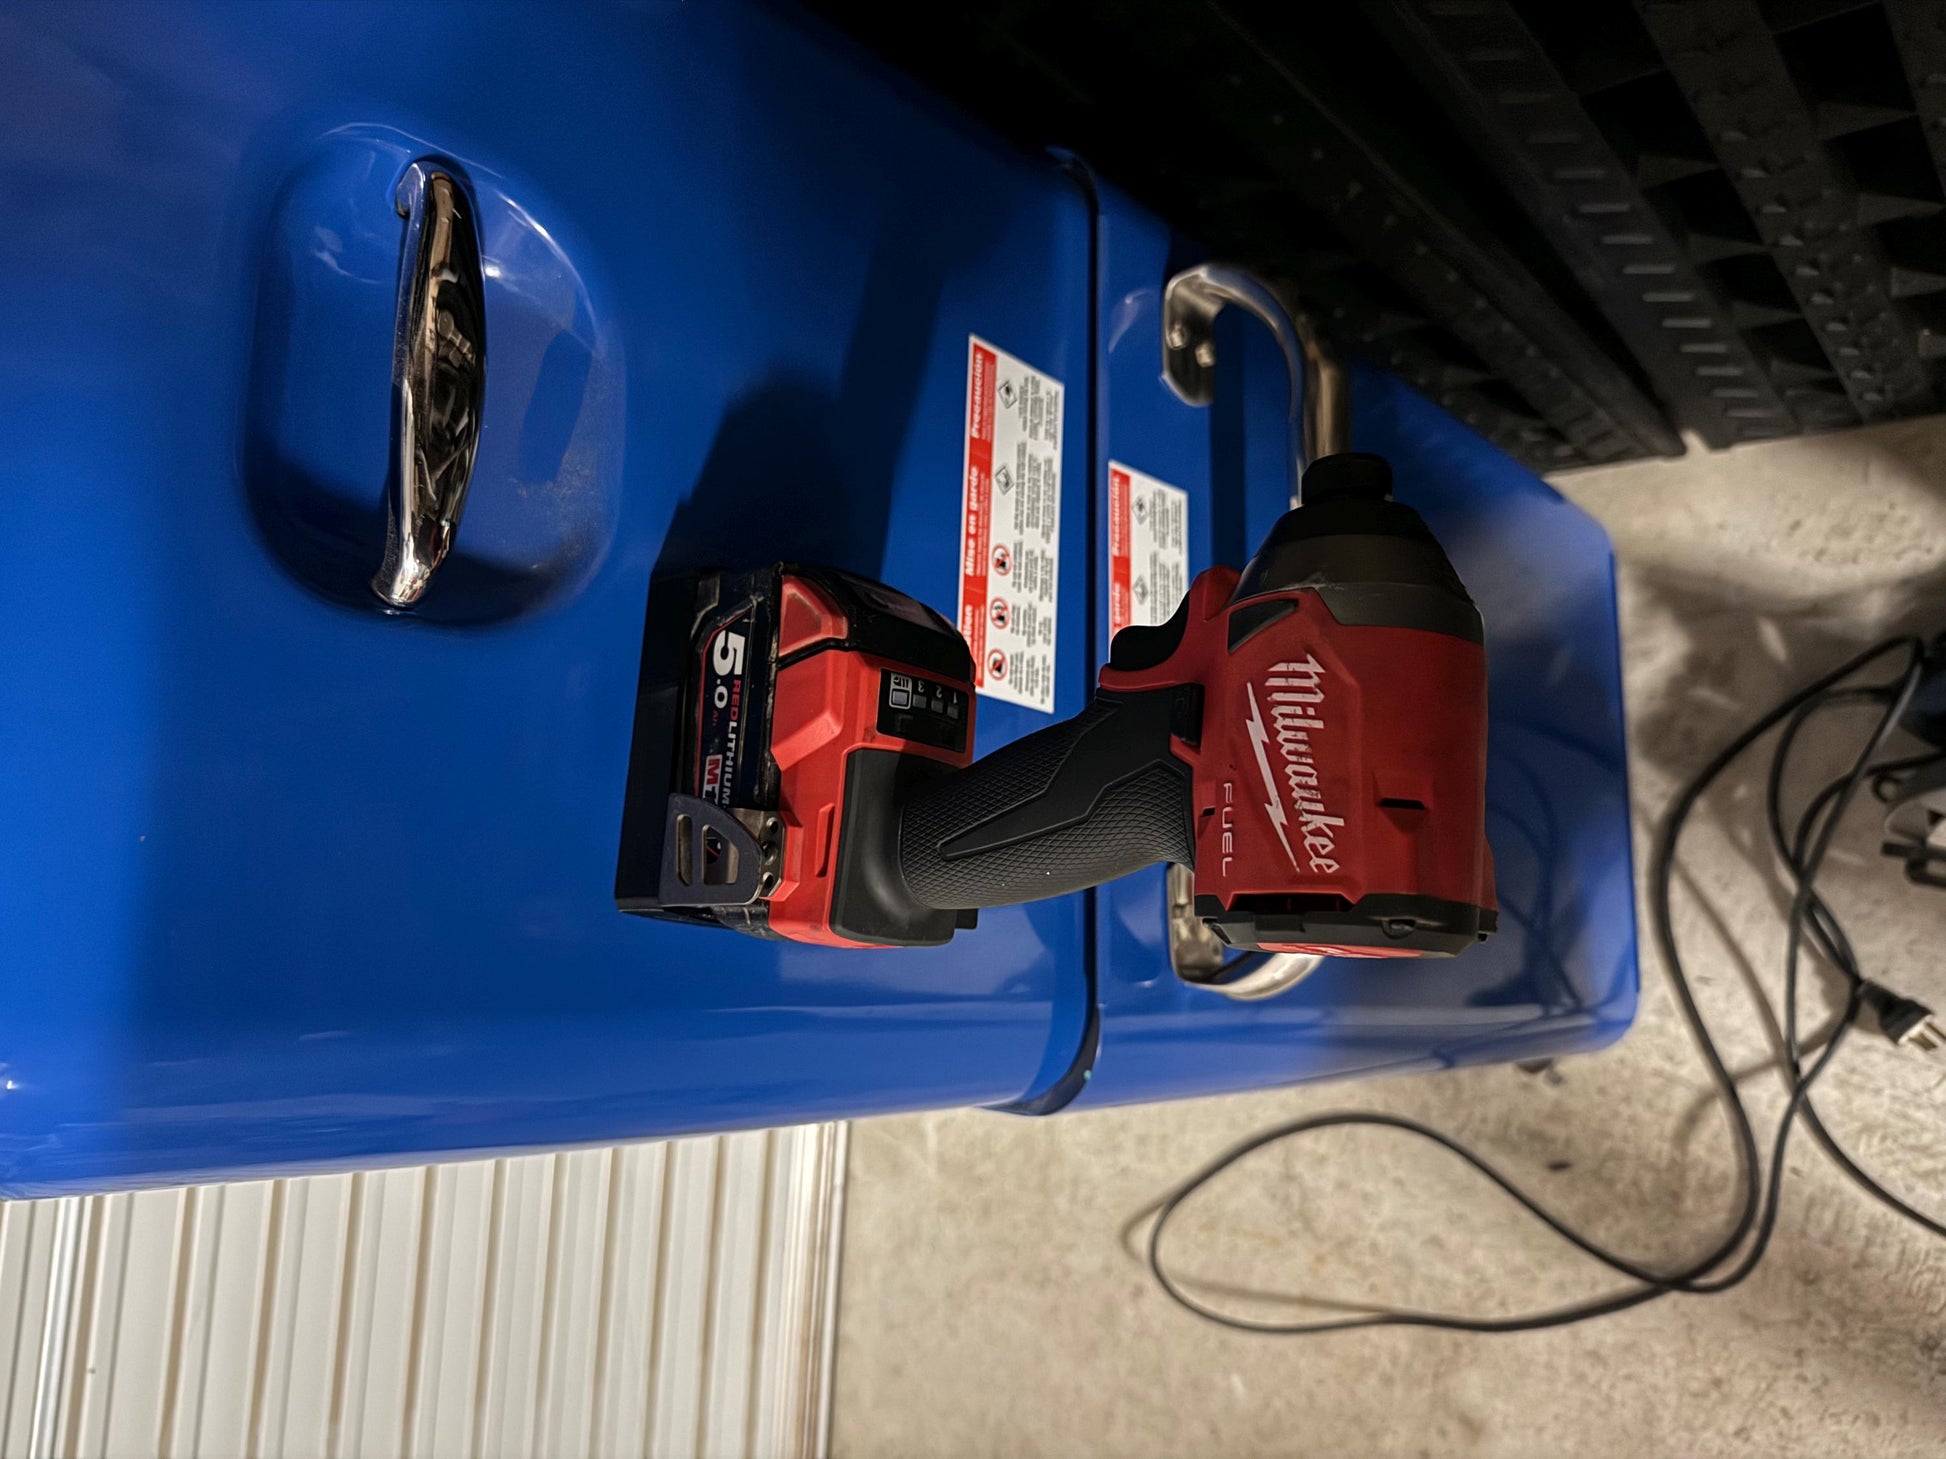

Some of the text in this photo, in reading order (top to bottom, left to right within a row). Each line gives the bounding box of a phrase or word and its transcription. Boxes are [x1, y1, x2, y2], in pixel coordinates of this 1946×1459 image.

[965, 466, 979, 577] Mise en garde
[713, 630, 746, 709] 5.0
[917, 680, 925, 693] 3
[936, 685, 942, 698] 2
[704, 757, 720, 804] M1
[1265, 653, 1345, 875] Milwaukee
[1222, 782, 1233, 877] FUEL
